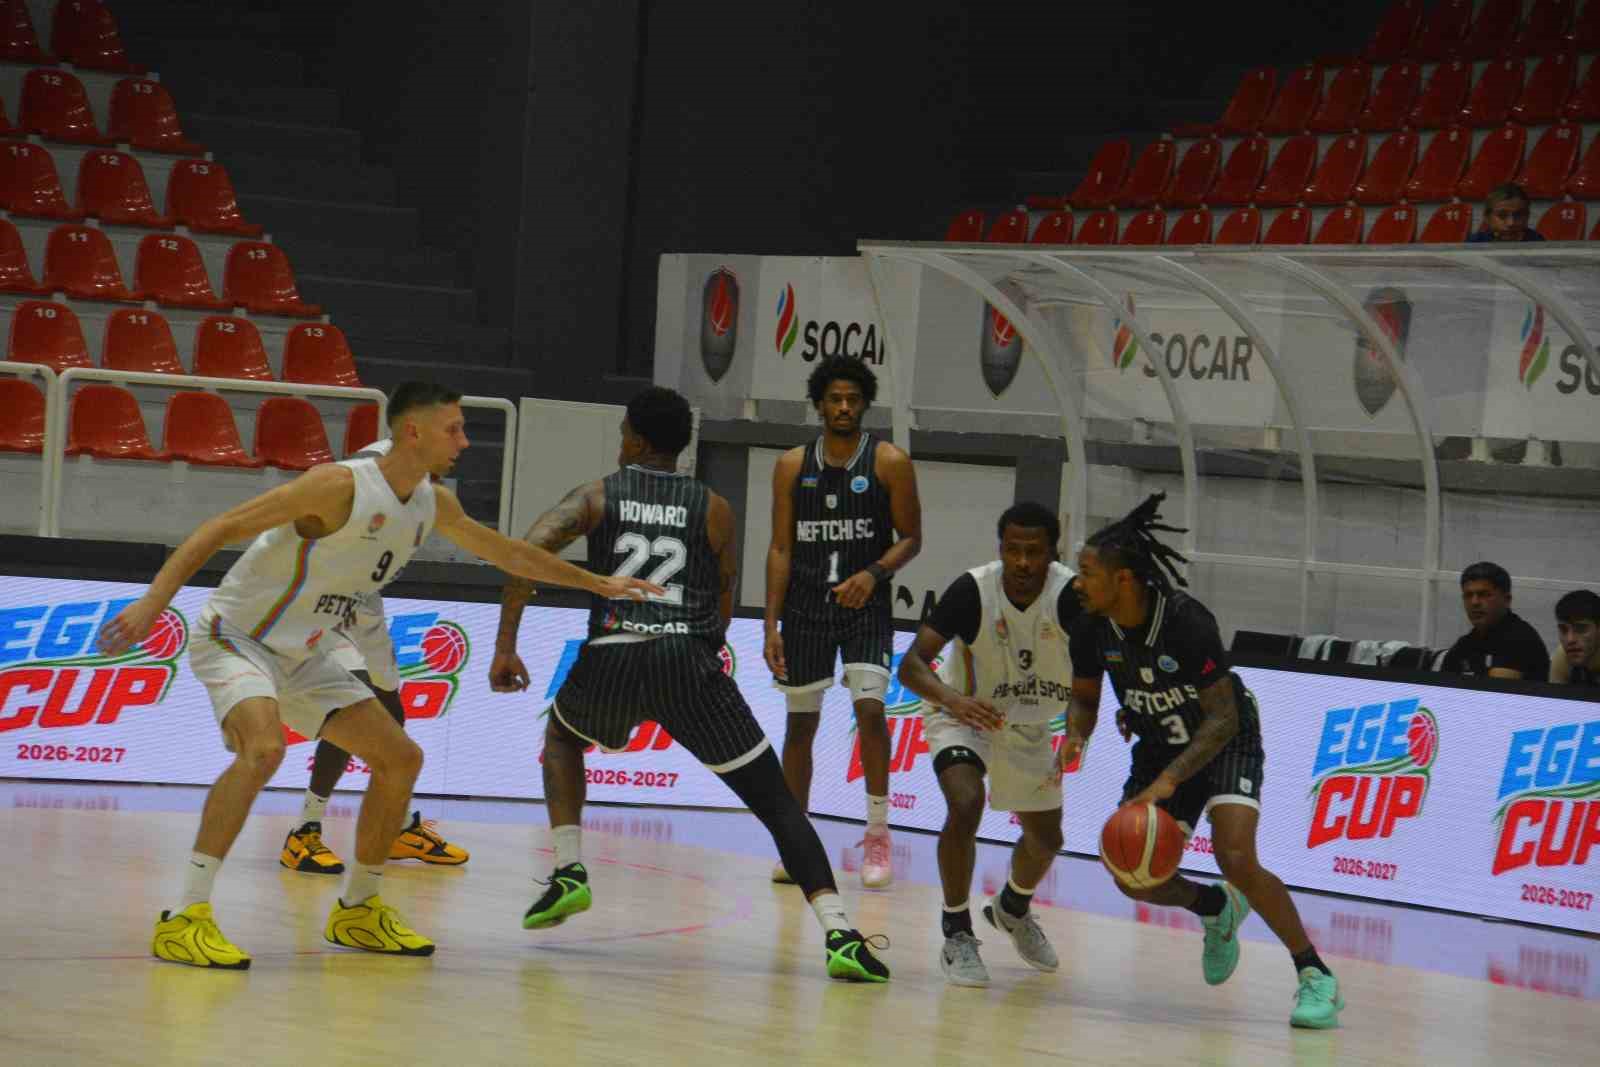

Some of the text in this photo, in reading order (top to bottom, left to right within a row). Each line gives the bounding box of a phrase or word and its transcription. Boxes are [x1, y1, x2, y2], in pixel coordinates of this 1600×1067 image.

[40, 74, 62, 87] 12
[132, 83, 154, 95] 13
[9, 145, 30, 158] 11
[99, 154, 121, 167] 12
[189, 163, 210, 176] 13
[1444, 208, 1460, 221] 11
[67, 232, 89, 243] 11
[157, 239, 179, 252] 12
[247, 247, 268, 260] 13
[33, 306, 57, 319] 10
[126, 313, 149, 326] 11
[214, 320, 236, 333] 12
[302, 326, 324, 339] 13
[619, 499, 688, 528] HOWARD
[796, 518, 875, 542] NEFTCHI SC
[371, 550, 394, 582] 9
[608, 531, 688, 606] 22
[827, 550, 839, 583] 1
[622, 619, 689, 636] SOCAR
[1018, 649, 1033, 671] 3
[0, 668, 169, 733] CUP
[1160, 714, 1190, 745] 3
[1312, 698, 1420, 777] EGE
[17, 744, 126, 763] 2026-2027
[1496, 719, 1600, 800] EGE
[584, 768, 679, 788] 2026-2027
[1306, 775, 1425, 849] CUP
[1332, 856, 1398, 881] 2026-2027
[1520, 883, 1594, 911] 2026-2027
